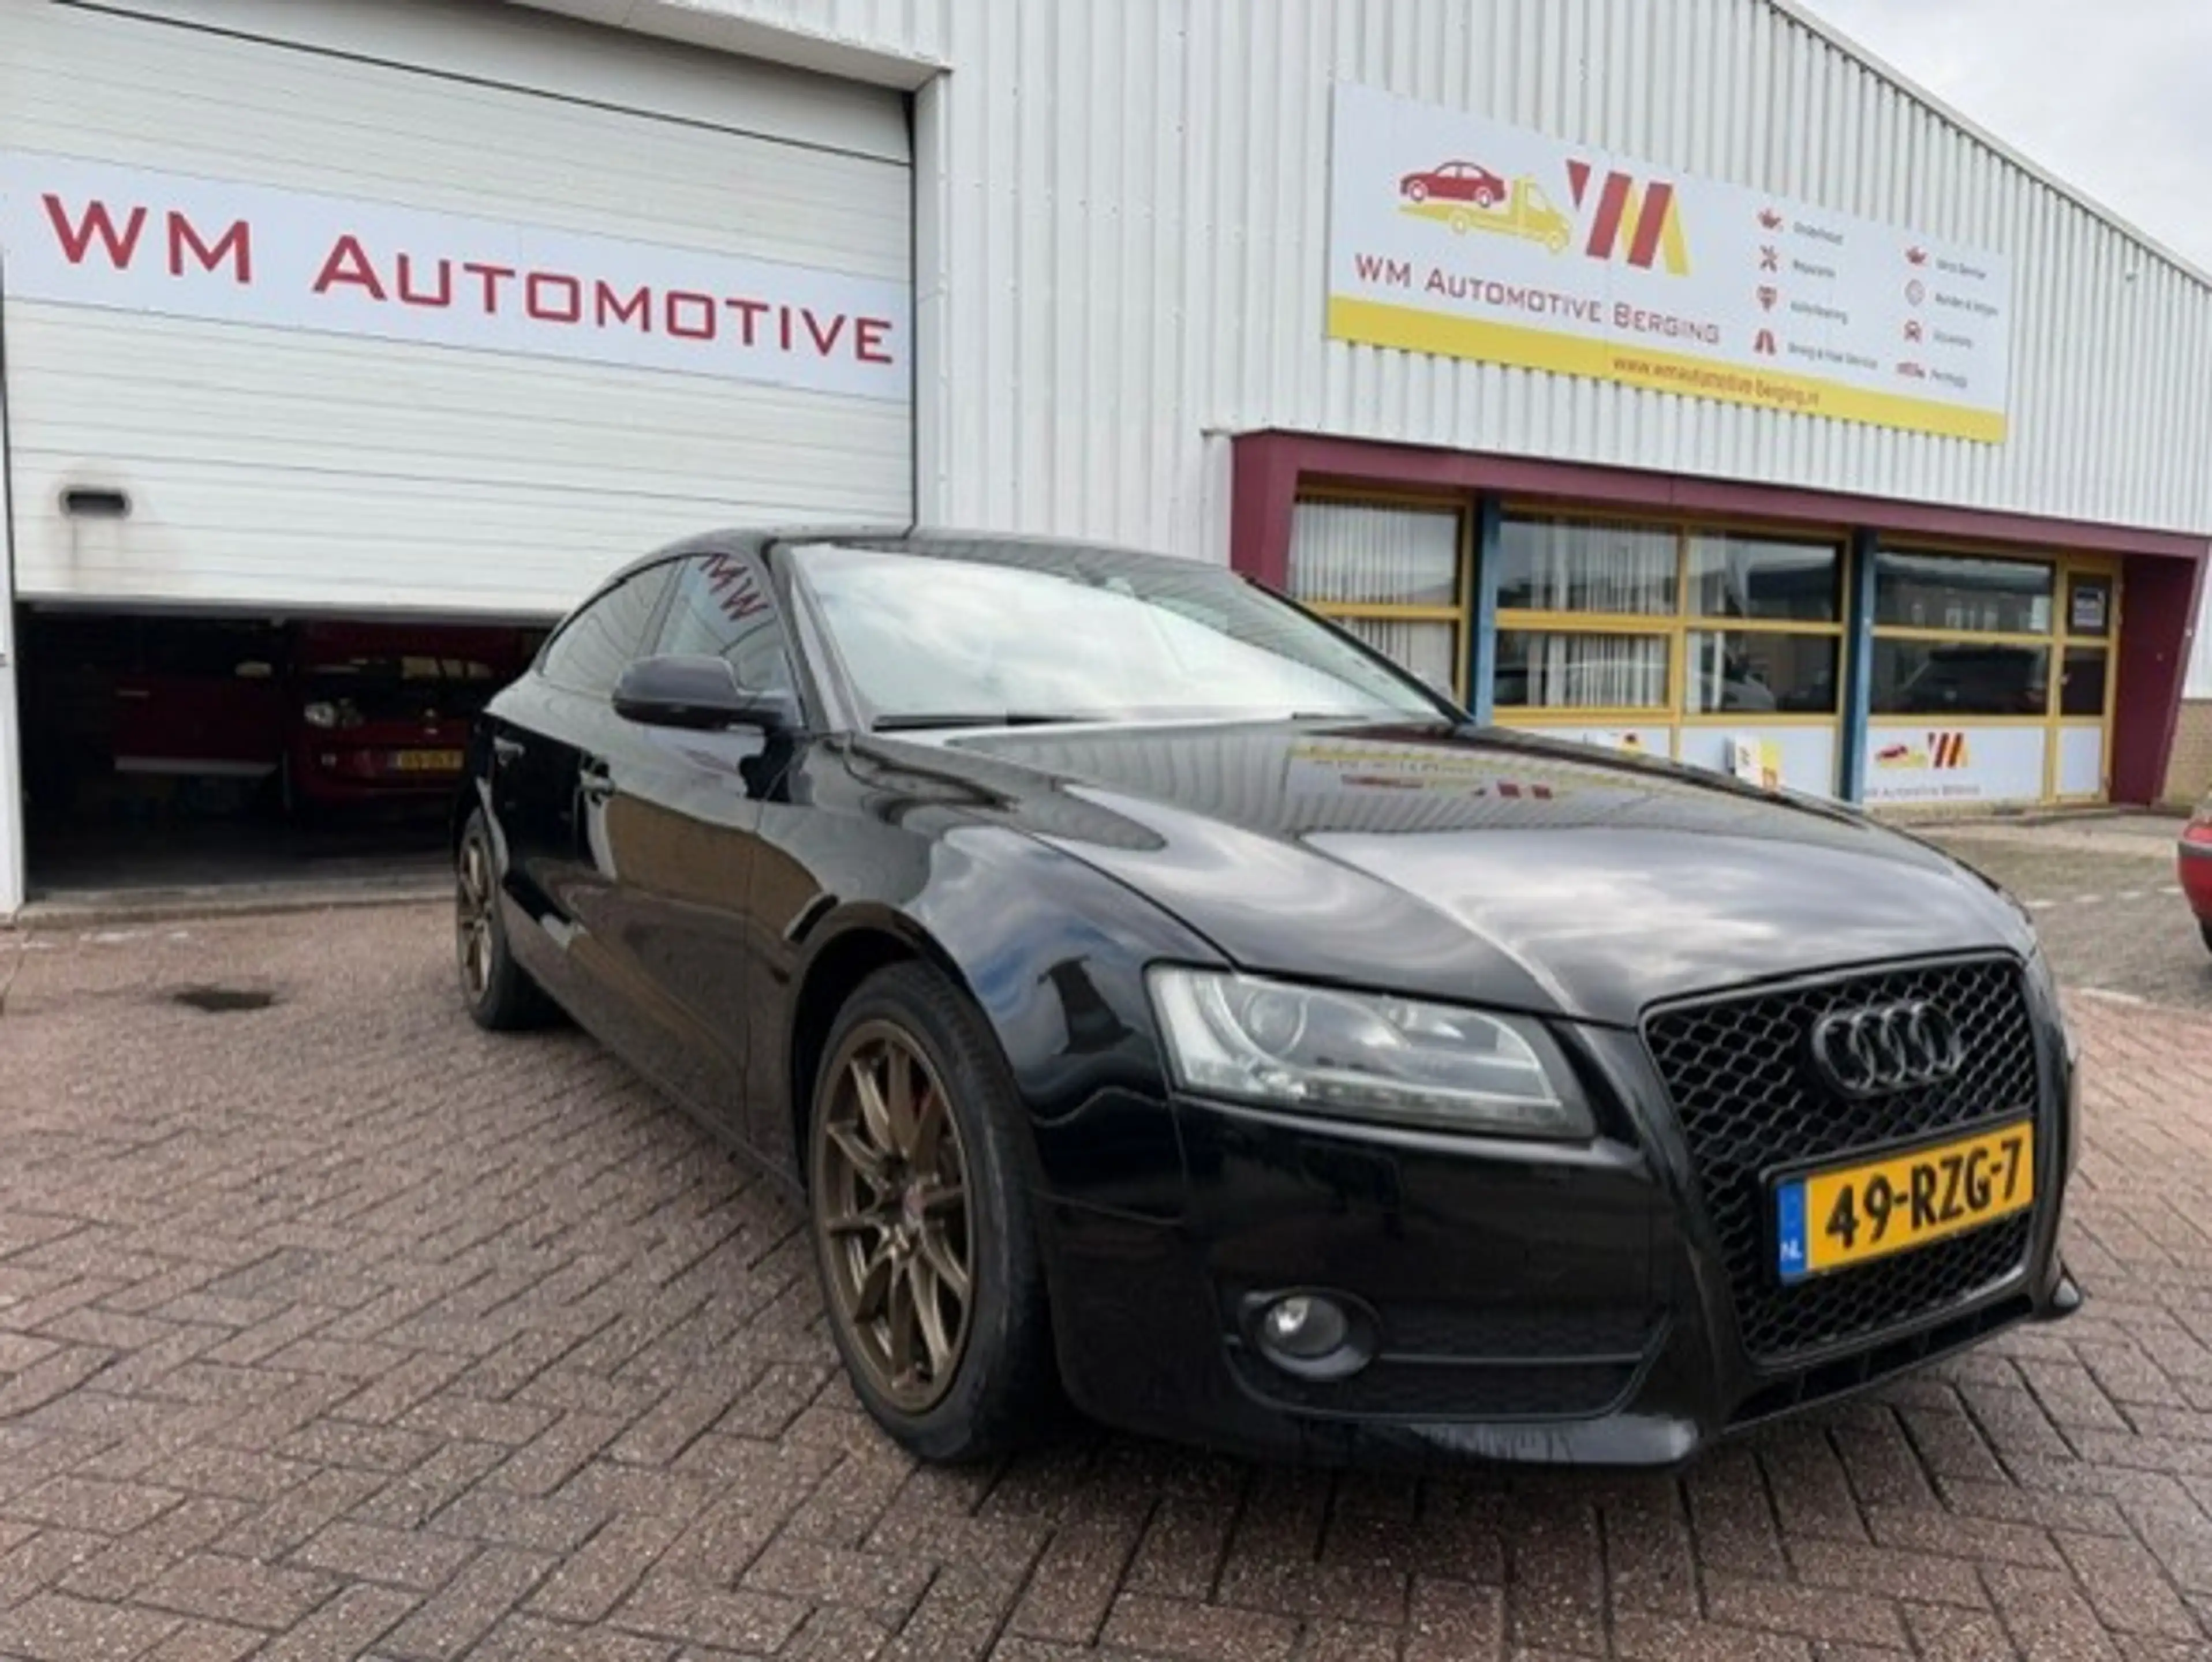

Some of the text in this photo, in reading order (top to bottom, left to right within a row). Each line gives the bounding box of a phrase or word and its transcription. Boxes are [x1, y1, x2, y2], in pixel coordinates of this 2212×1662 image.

[42, 193, 893, 364] WM AUTOMOTIVE
[1354, 253, 1721, 345] WM AUTOMOTIVE BERGING
[1825, 1137, 2023, 1249] 49-RZG-7
[1780, 1239, 1804, 1262] NL
